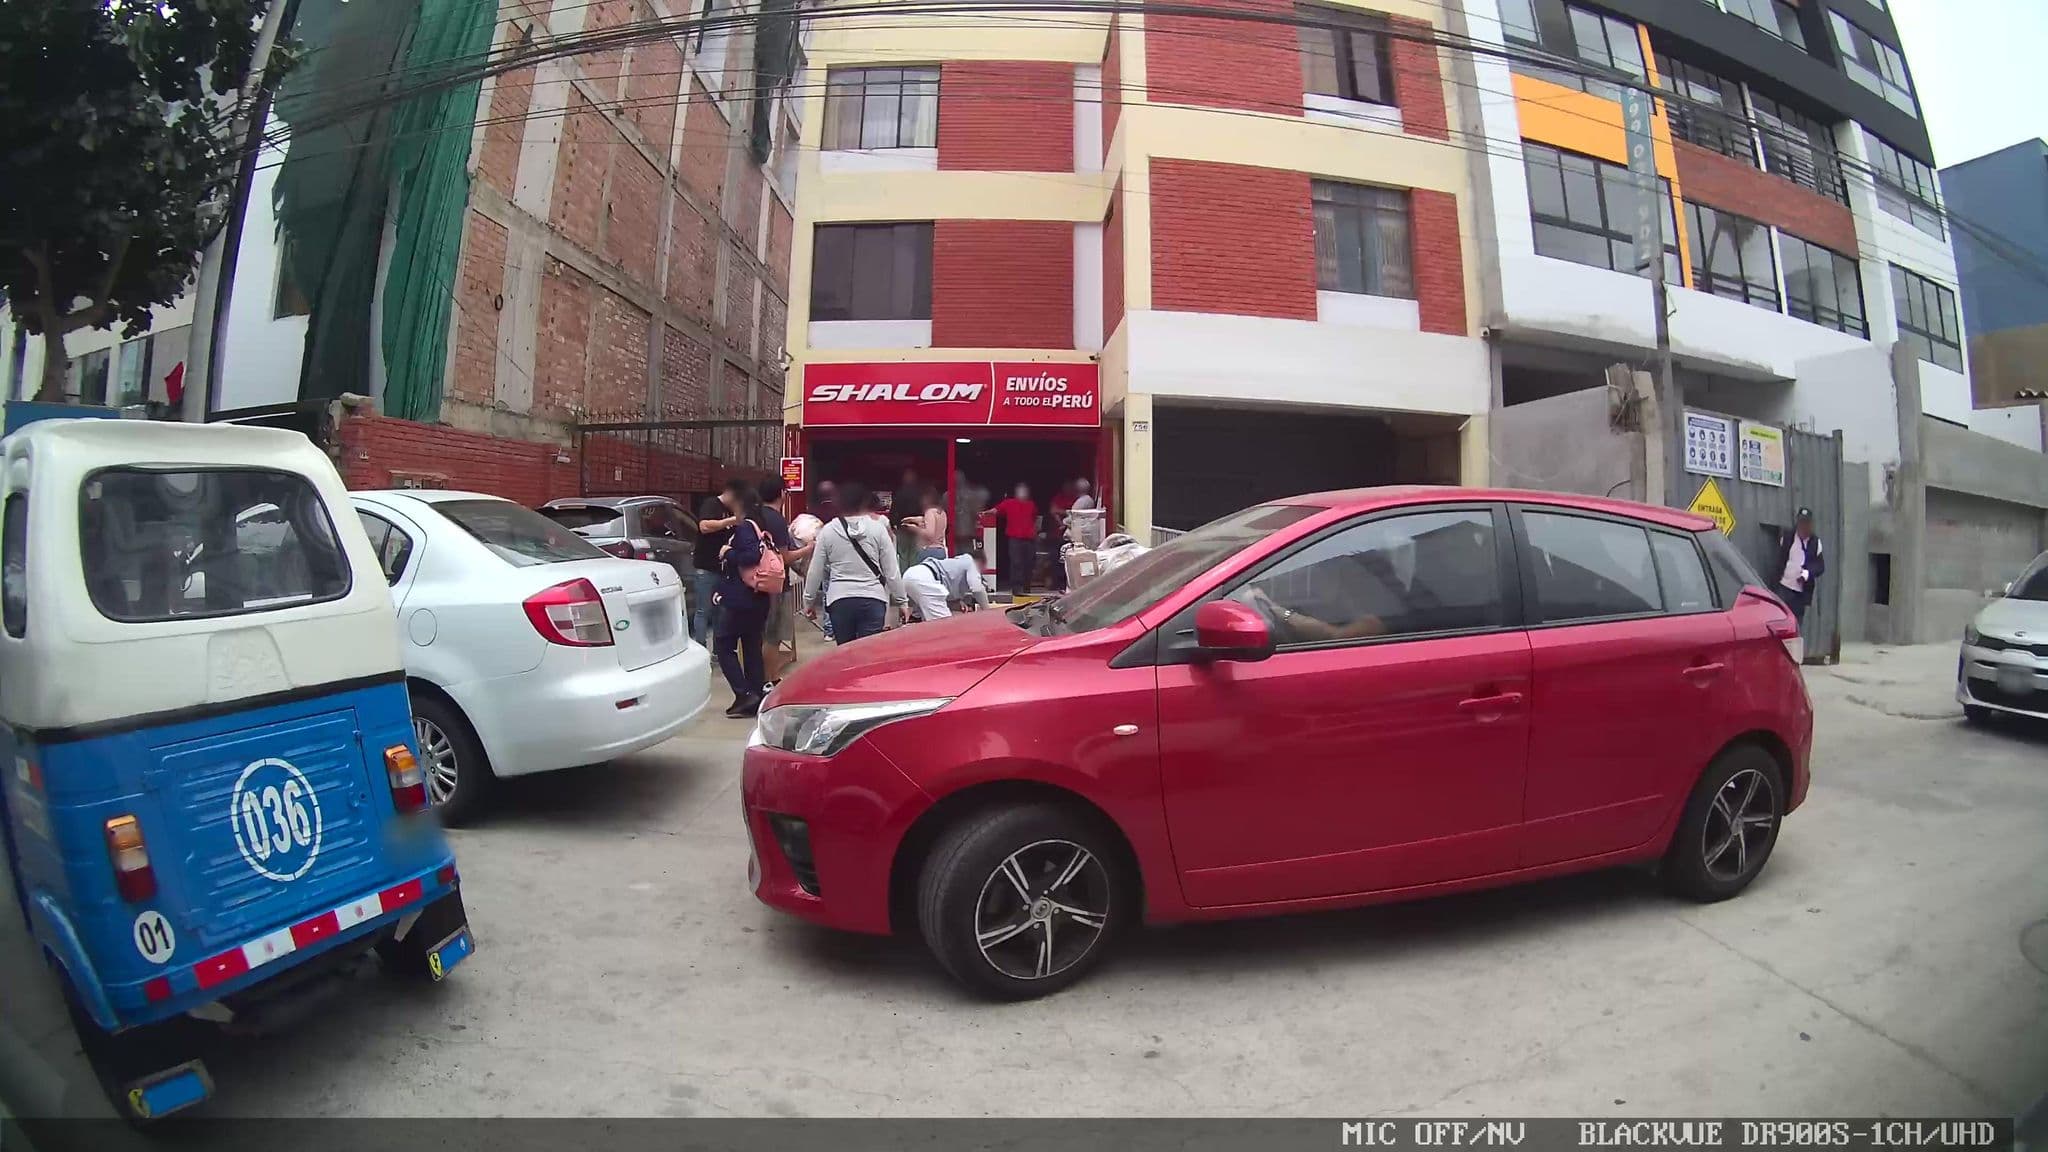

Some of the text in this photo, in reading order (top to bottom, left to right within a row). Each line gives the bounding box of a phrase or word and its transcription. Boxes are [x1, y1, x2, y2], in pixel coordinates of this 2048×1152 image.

[1006, 371, 1067, 391] ENVÍOS
[808, 383, 983, 402] SHALOM
[1003, 390, 1093, 408] A TODO EL PERÚ
[242, 780, 311, 861] 036
[139, 917, 170, 955] 01
